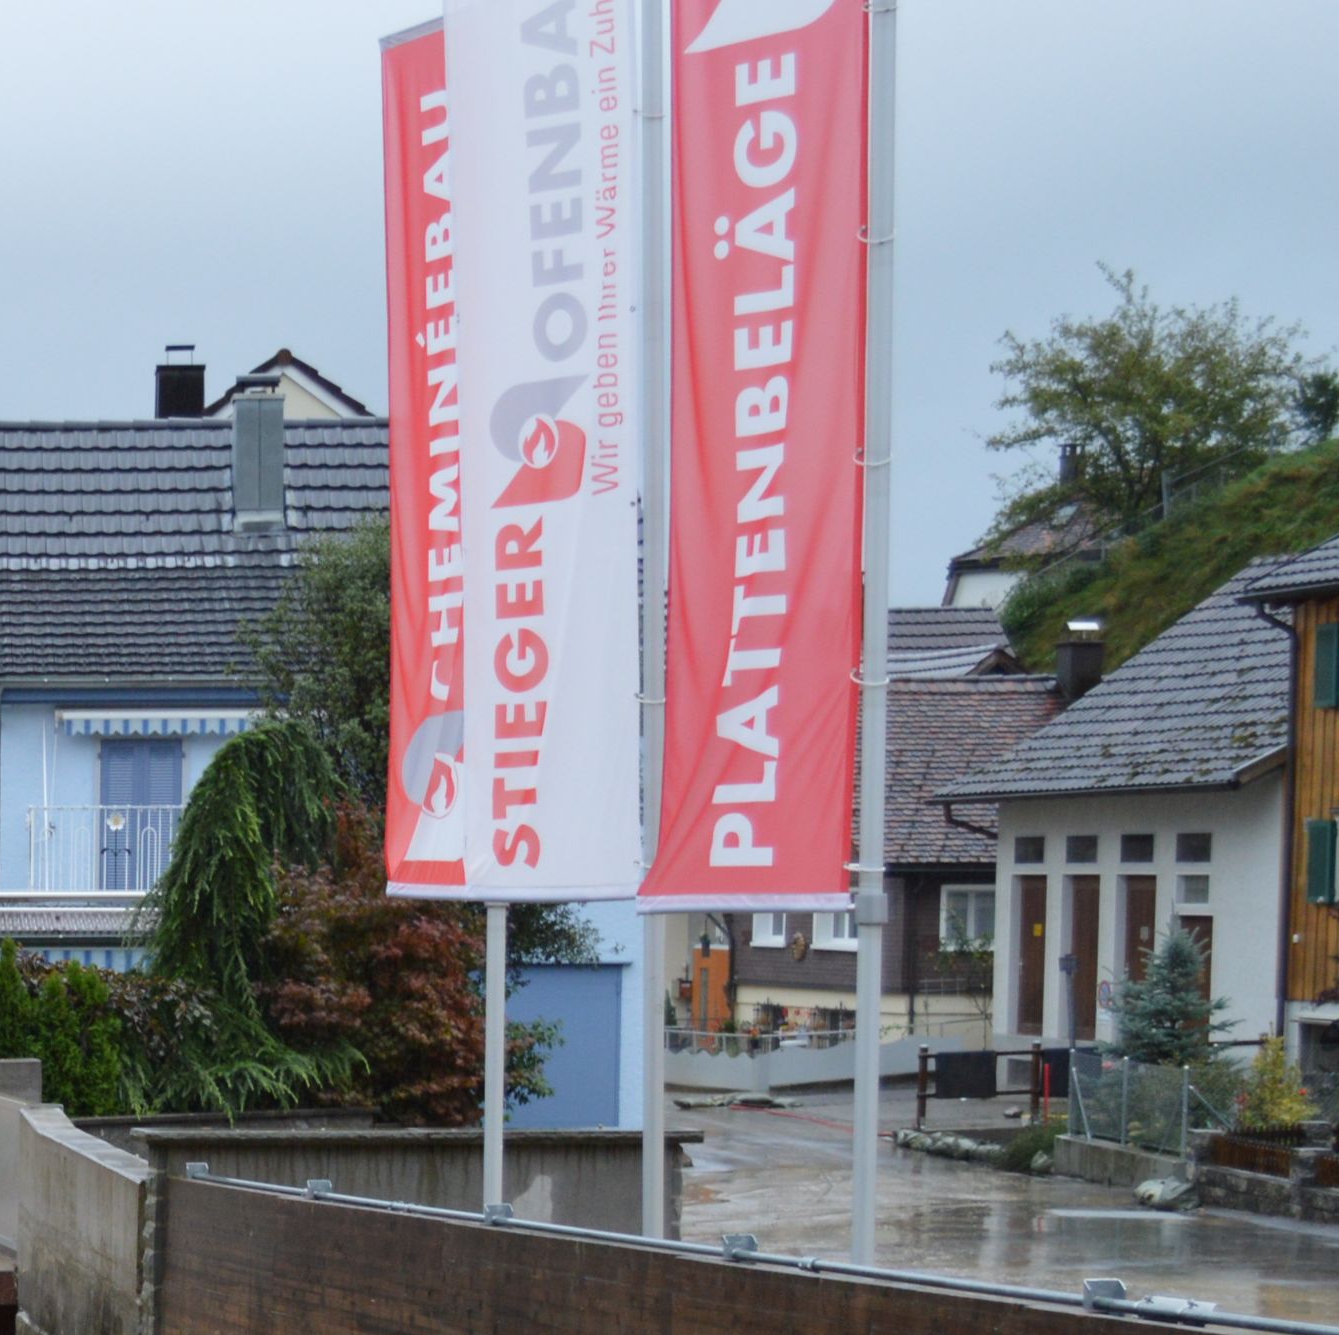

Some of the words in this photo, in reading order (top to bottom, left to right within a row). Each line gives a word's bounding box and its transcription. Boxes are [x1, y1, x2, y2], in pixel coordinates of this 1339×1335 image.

[591, 66, 618, 112] ein
[595, 124, 619, 240] Wärme
[593, 332, 624, 428] geben
[591, 440, 619, 496] Wir
[709, 52, 798, 867] PLATTENBELÄGE
[492, 516, 549, 869] STIEGER
